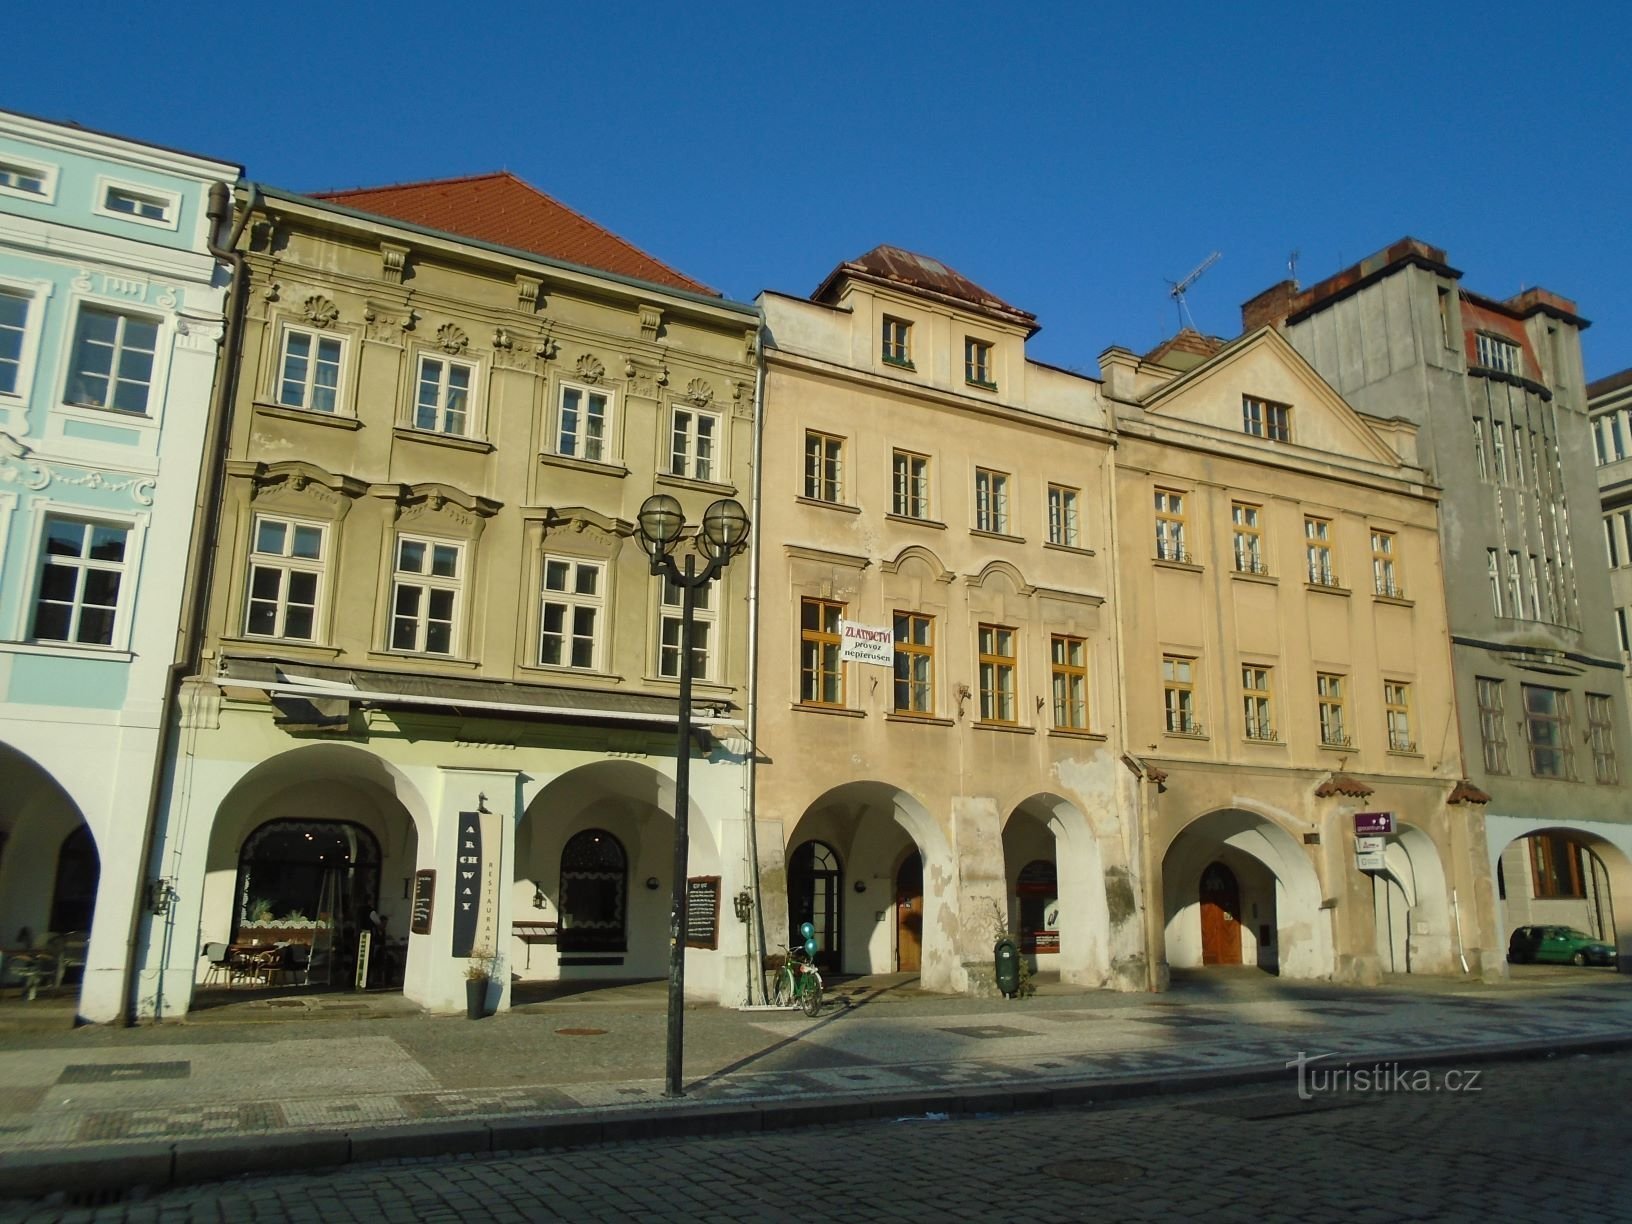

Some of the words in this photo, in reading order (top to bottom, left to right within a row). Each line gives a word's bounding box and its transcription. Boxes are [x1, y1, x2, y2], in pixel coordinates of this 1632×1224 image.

[845, 650, 890, 662] nepřerušen
[855, 641, 881, 651] provoz
[460, 825, 478, 911] ARCHWAY
[485, 862, 493, 950] RESTAURANT
